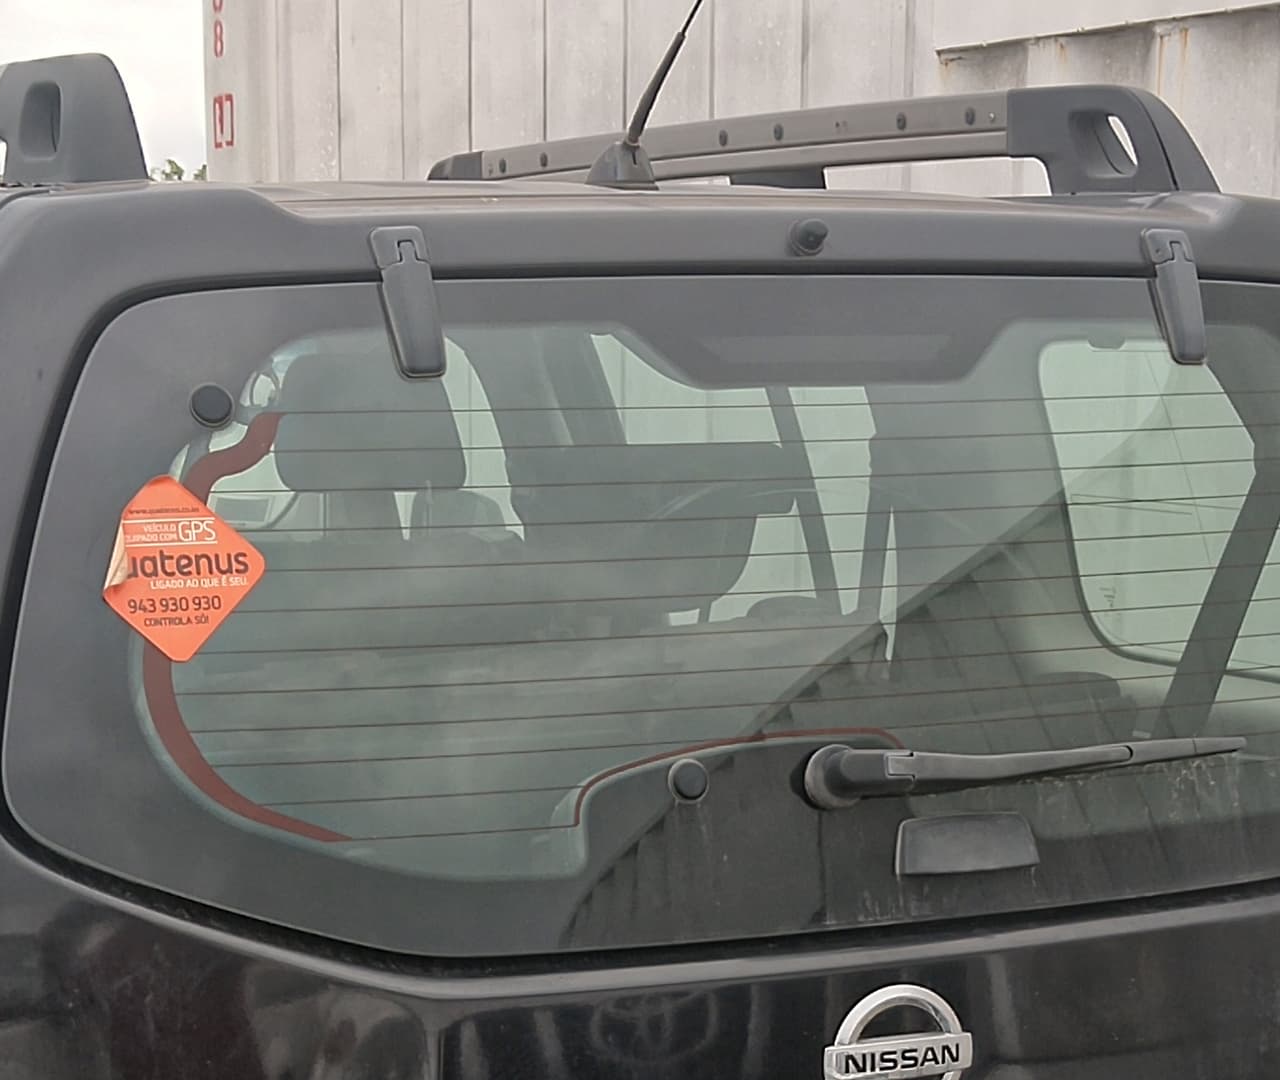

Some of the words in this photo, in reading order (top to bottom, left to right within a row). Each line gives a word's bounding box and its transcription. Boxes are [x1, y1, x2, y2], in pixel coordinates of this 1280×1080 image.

[143, 522, 177, 533] VEÍCULO
[178, 520, 217, 542] GPS
[125, 533, 158, 543] UIPADO
[159, 533, 177, 542] COM
[127, 549, 249, 579] uatenus
[150, 579, 184, 590] LIGADO
[186, 578, 199, 588] AO
[201, 577, 220, 589] QUE
[127, 598, 157, 614] 943
[159, 596, 190, 613] 930
[192, 595, 222, 611] 930
[144, 616, 193, 627] CONTROLA
[843, 1042, 961, 1075] NISSAN
